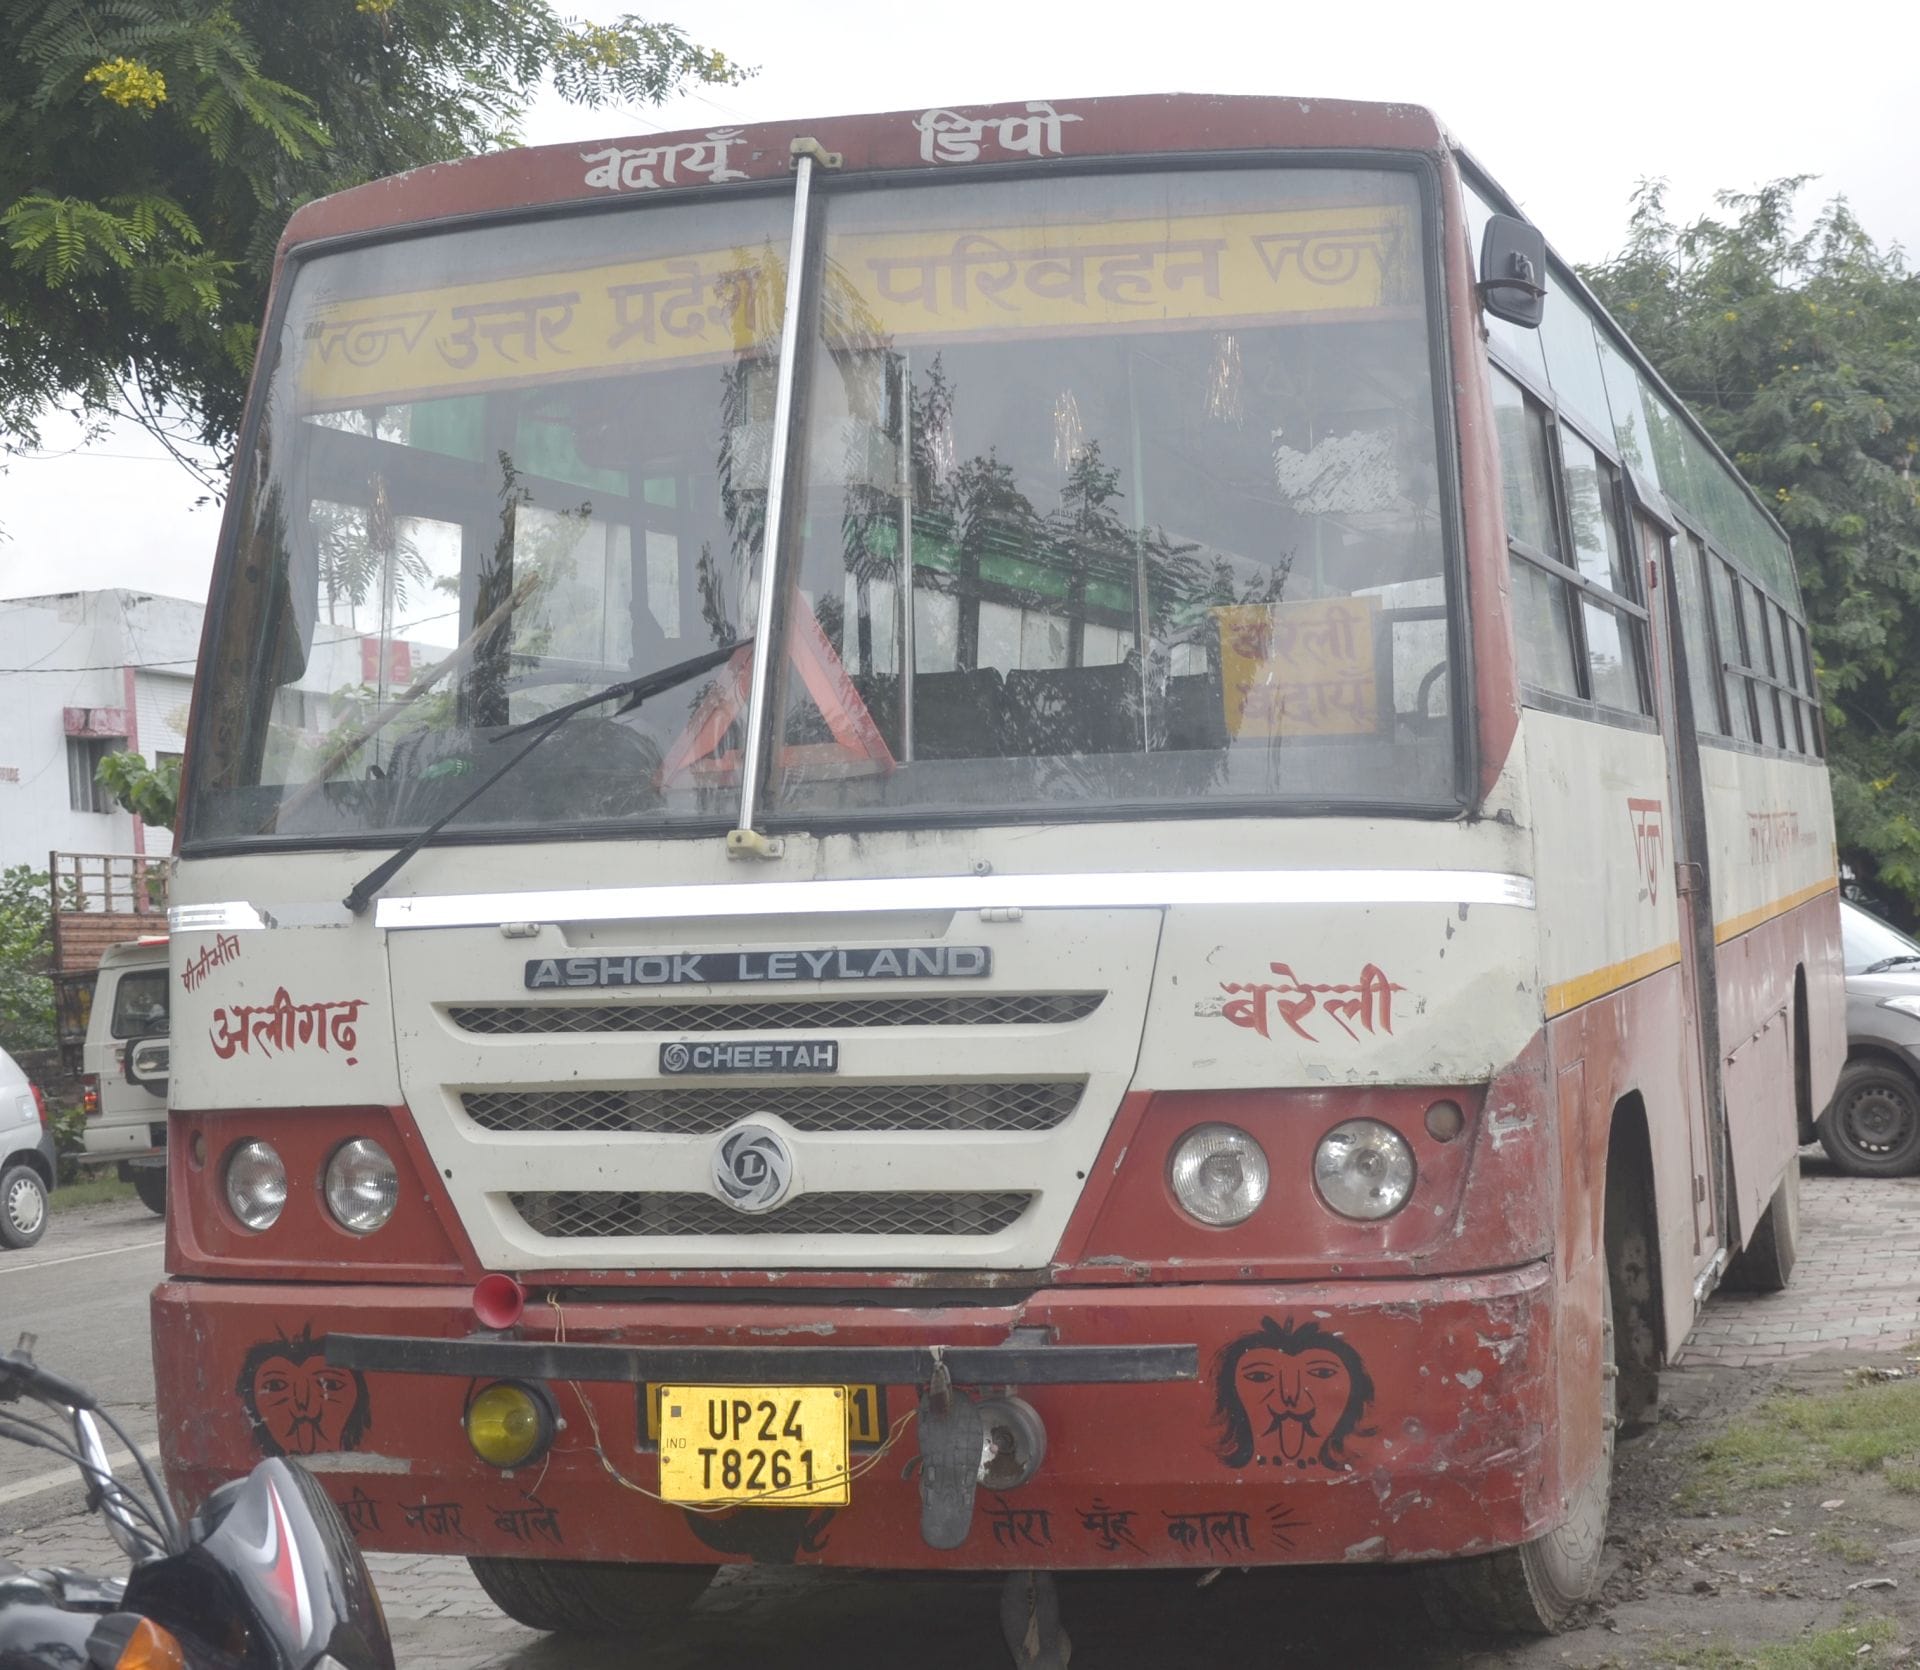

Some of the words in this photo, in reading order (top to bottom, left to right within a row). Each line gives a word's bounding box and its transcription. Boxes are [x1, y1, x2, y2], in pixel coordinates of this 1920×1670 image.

[912, 101, 1084, 163] डिपो
[435, 290, 582, 370] उत्तर
[866, 234, 1228, 315] परिवहन
[531, 955, 705, 988] ASHOK
[738, 945, 986, 980] LEYLAND
[209, 986, 369, 1067] अलीगढ़
[1219, 962, 1407, 1043] बरेली
[693, 1043, 834, 1070] CHEETAH
[666, 1437, 687, 1450] IND
[708, 1399, 803, 1441] UP24
[698, 1448, 814, 1490] T8261
[982, 1496, 1055, 1548] तेरा
[1161, 1509, 1256, 1557] काला
